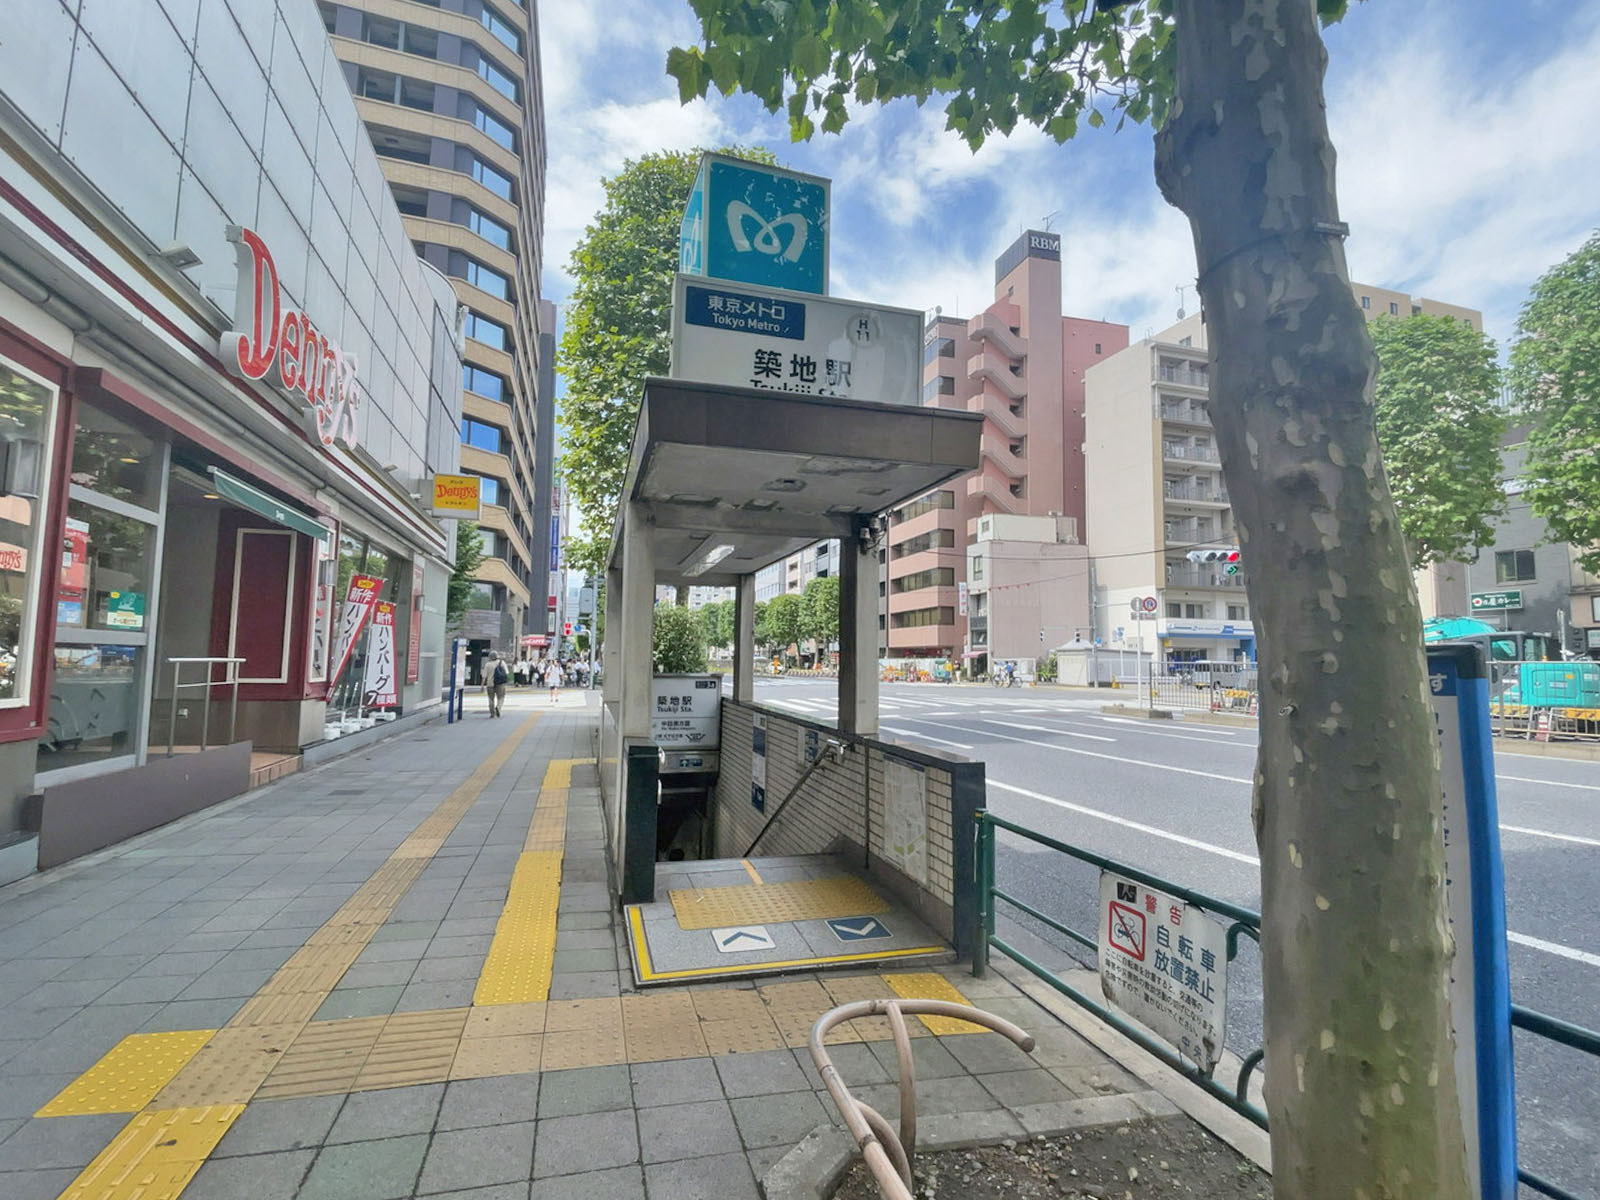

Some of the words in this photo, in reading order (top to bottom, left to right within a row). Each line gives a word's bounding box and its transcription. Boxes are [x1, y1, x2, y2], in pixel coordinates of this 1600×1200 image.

[1031, 235, 1060, 252] RBM
[708, 295, 786, 320] 東京メトロ
[712, 312, 745, 328] Tokyo
[747, 318, 781, 333] Metro
[858, 319, 868, 330] H
[856, 329, 870, 342] 11
[753, 348, 852, 387] 築地駅
[436, 484, 478, 500] Denny's
[376, 612, 393, 625] 新作
[375, 626, 391, 691] ハンバーグ
[657, 696, 692, 706] 築地駅
[1145, 893, 1183, 926] 警告
[1156, 924, 1217, 974] 自転車
[1154, 949, 1215, 1004] 放置禁止
